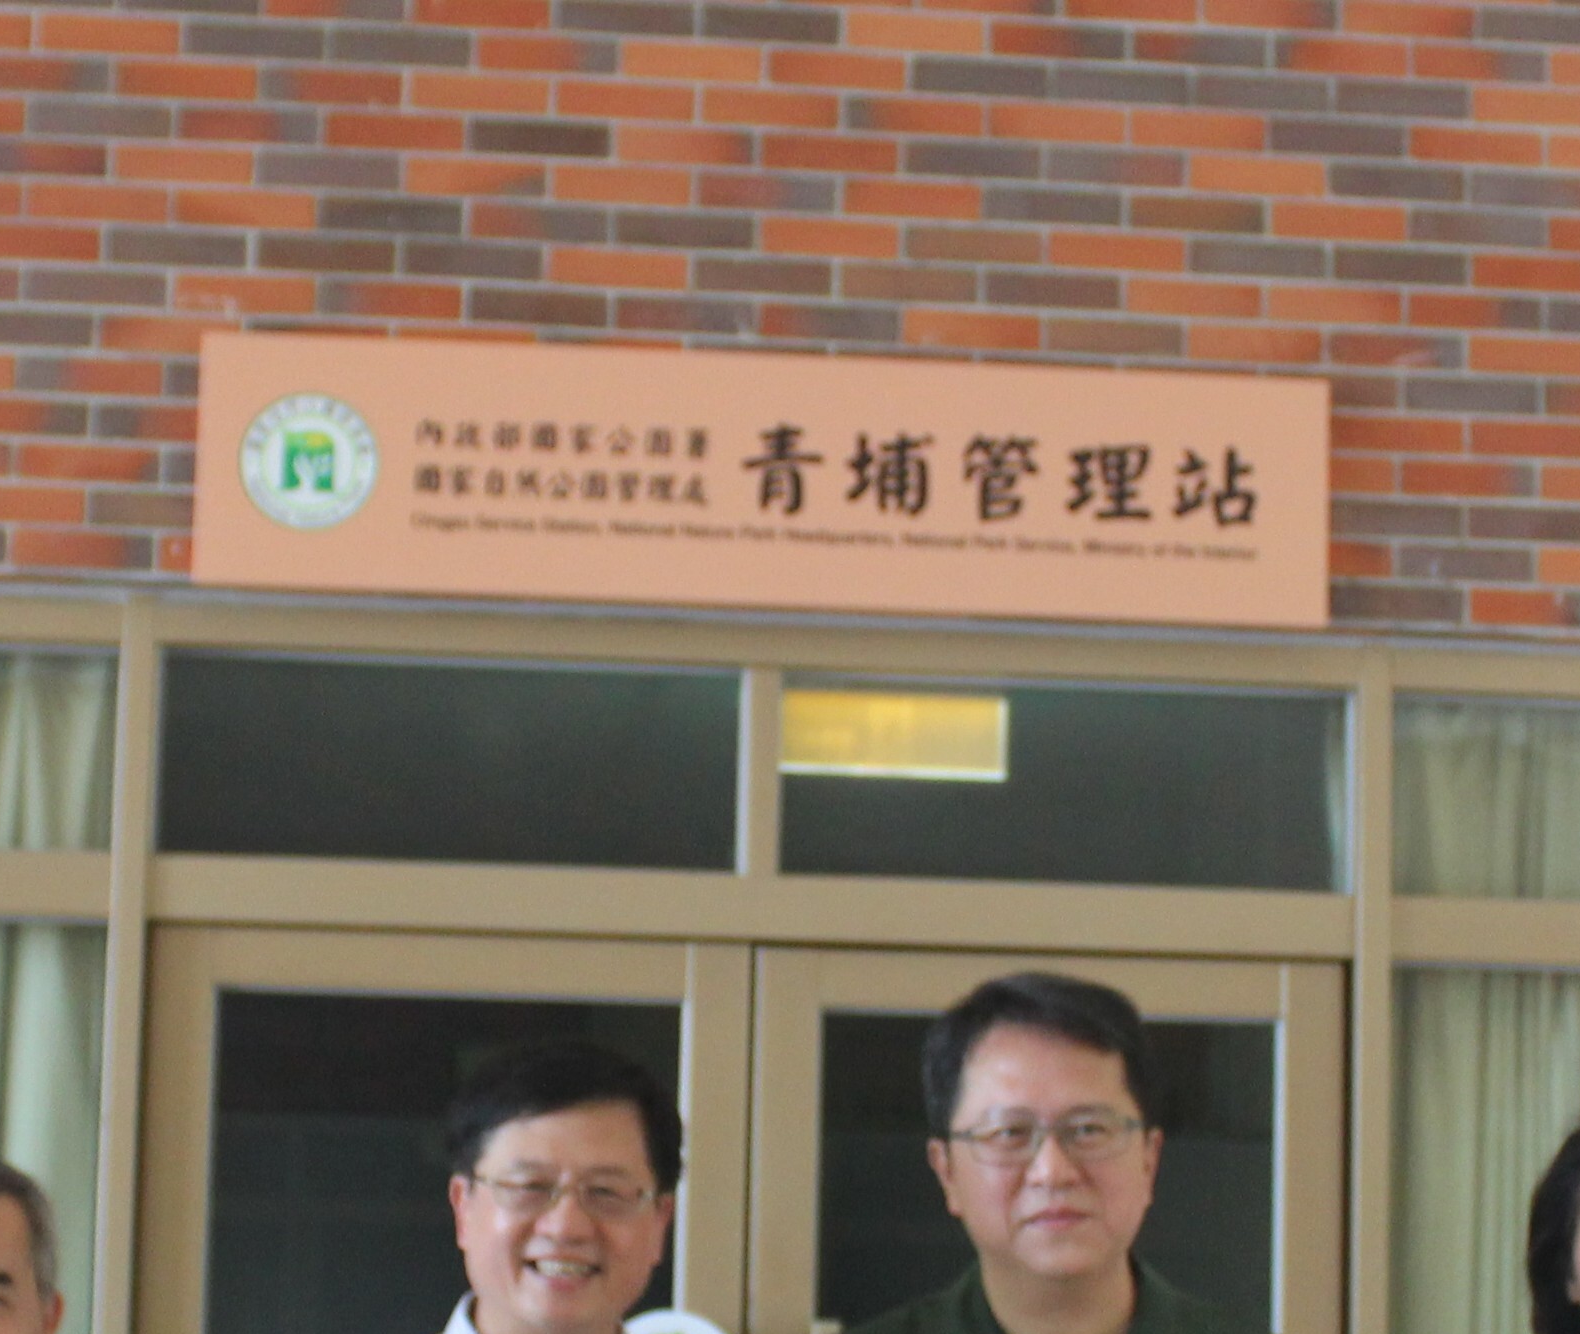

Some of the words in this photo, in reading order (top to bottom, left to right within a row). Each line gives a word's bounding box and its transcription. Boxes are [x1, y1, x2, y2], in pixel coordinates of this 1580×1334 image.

[741, 423, 1258, 528] 青埔管理站
